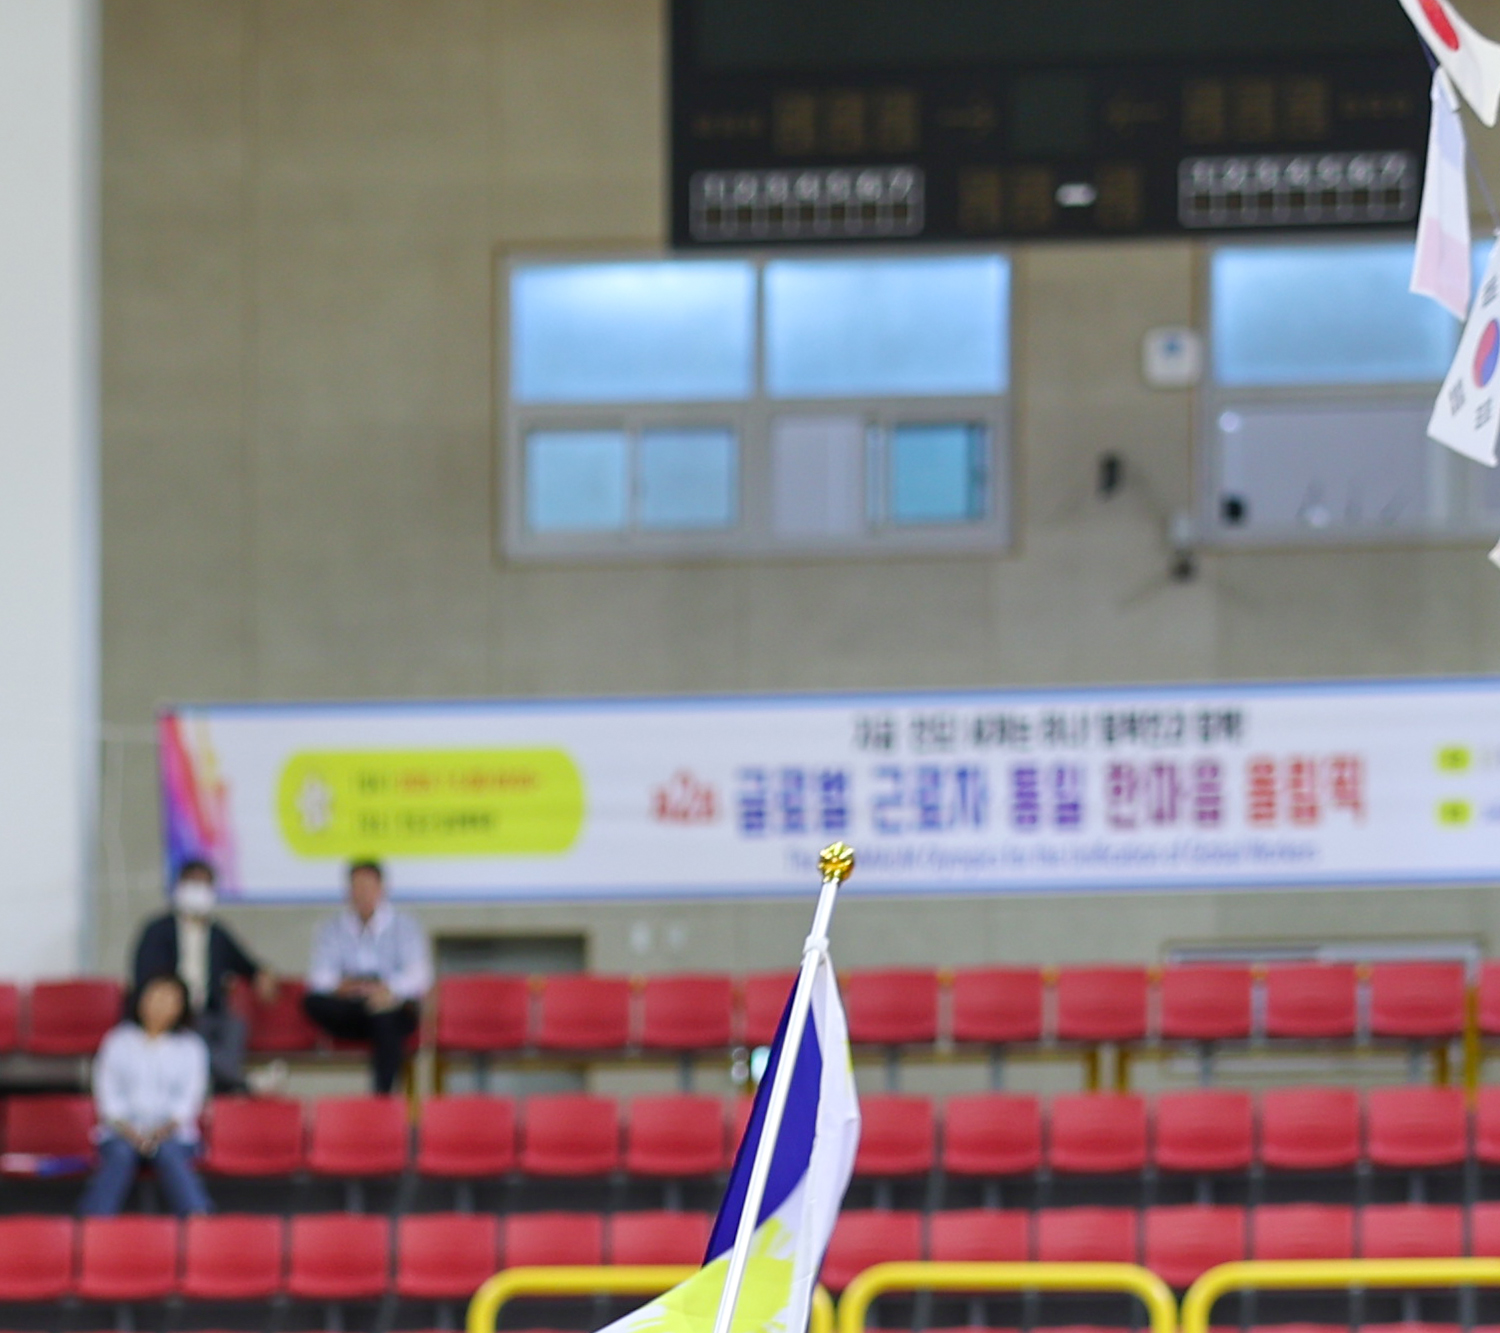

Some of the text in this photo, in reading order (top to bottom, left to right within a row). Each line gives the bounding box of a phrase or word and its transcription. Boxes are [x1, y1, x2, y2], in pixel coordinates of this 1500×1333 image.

[738, 764, 850, 834] 글로벌
[869, 764, 988, 836] 근로자
[1011, 762, 1083, 830] 통일
[1106, 760, 1223, 830] 한마음
[1247, 757, 1368, 827] 올림픽
